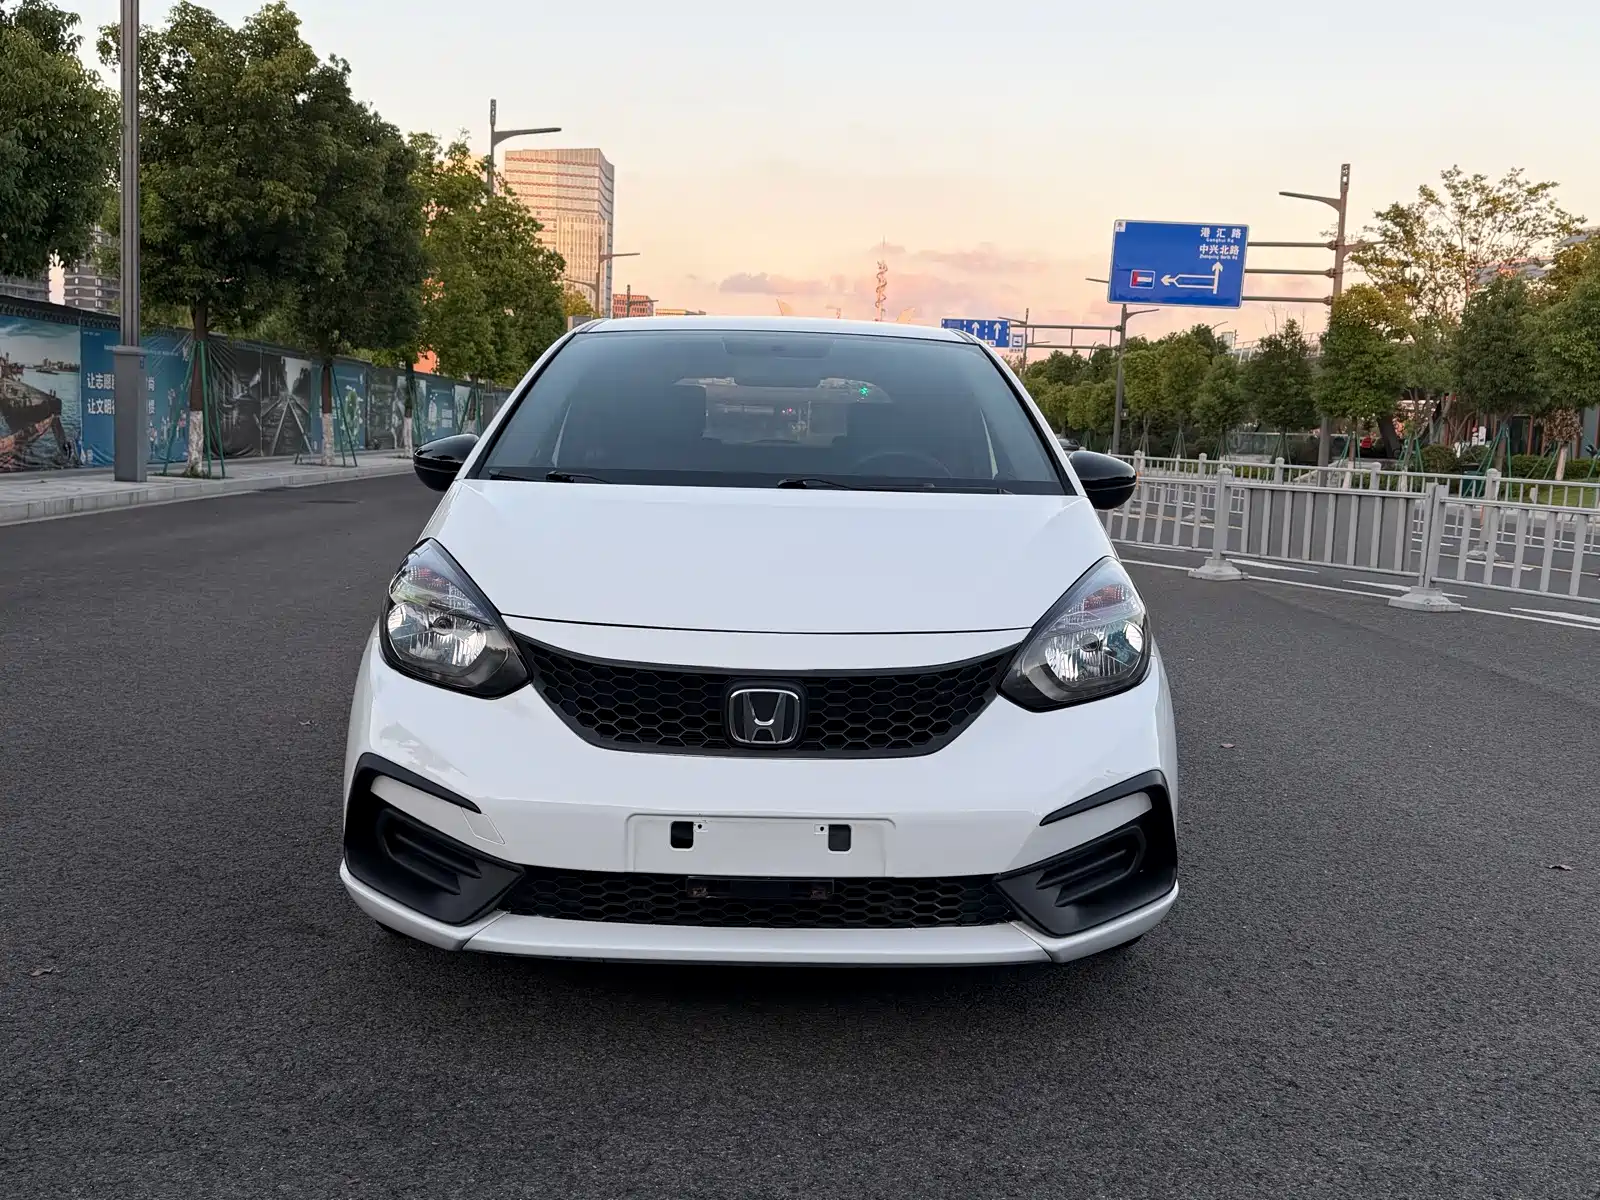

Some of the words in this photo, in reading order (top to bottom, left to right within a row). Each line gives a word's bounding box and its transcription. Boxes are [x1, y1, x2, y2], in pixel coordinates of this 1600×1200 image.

[1200, 227, 1241, 238] 港汇路
[1199, 244, 1239, 255] 中兴北路
